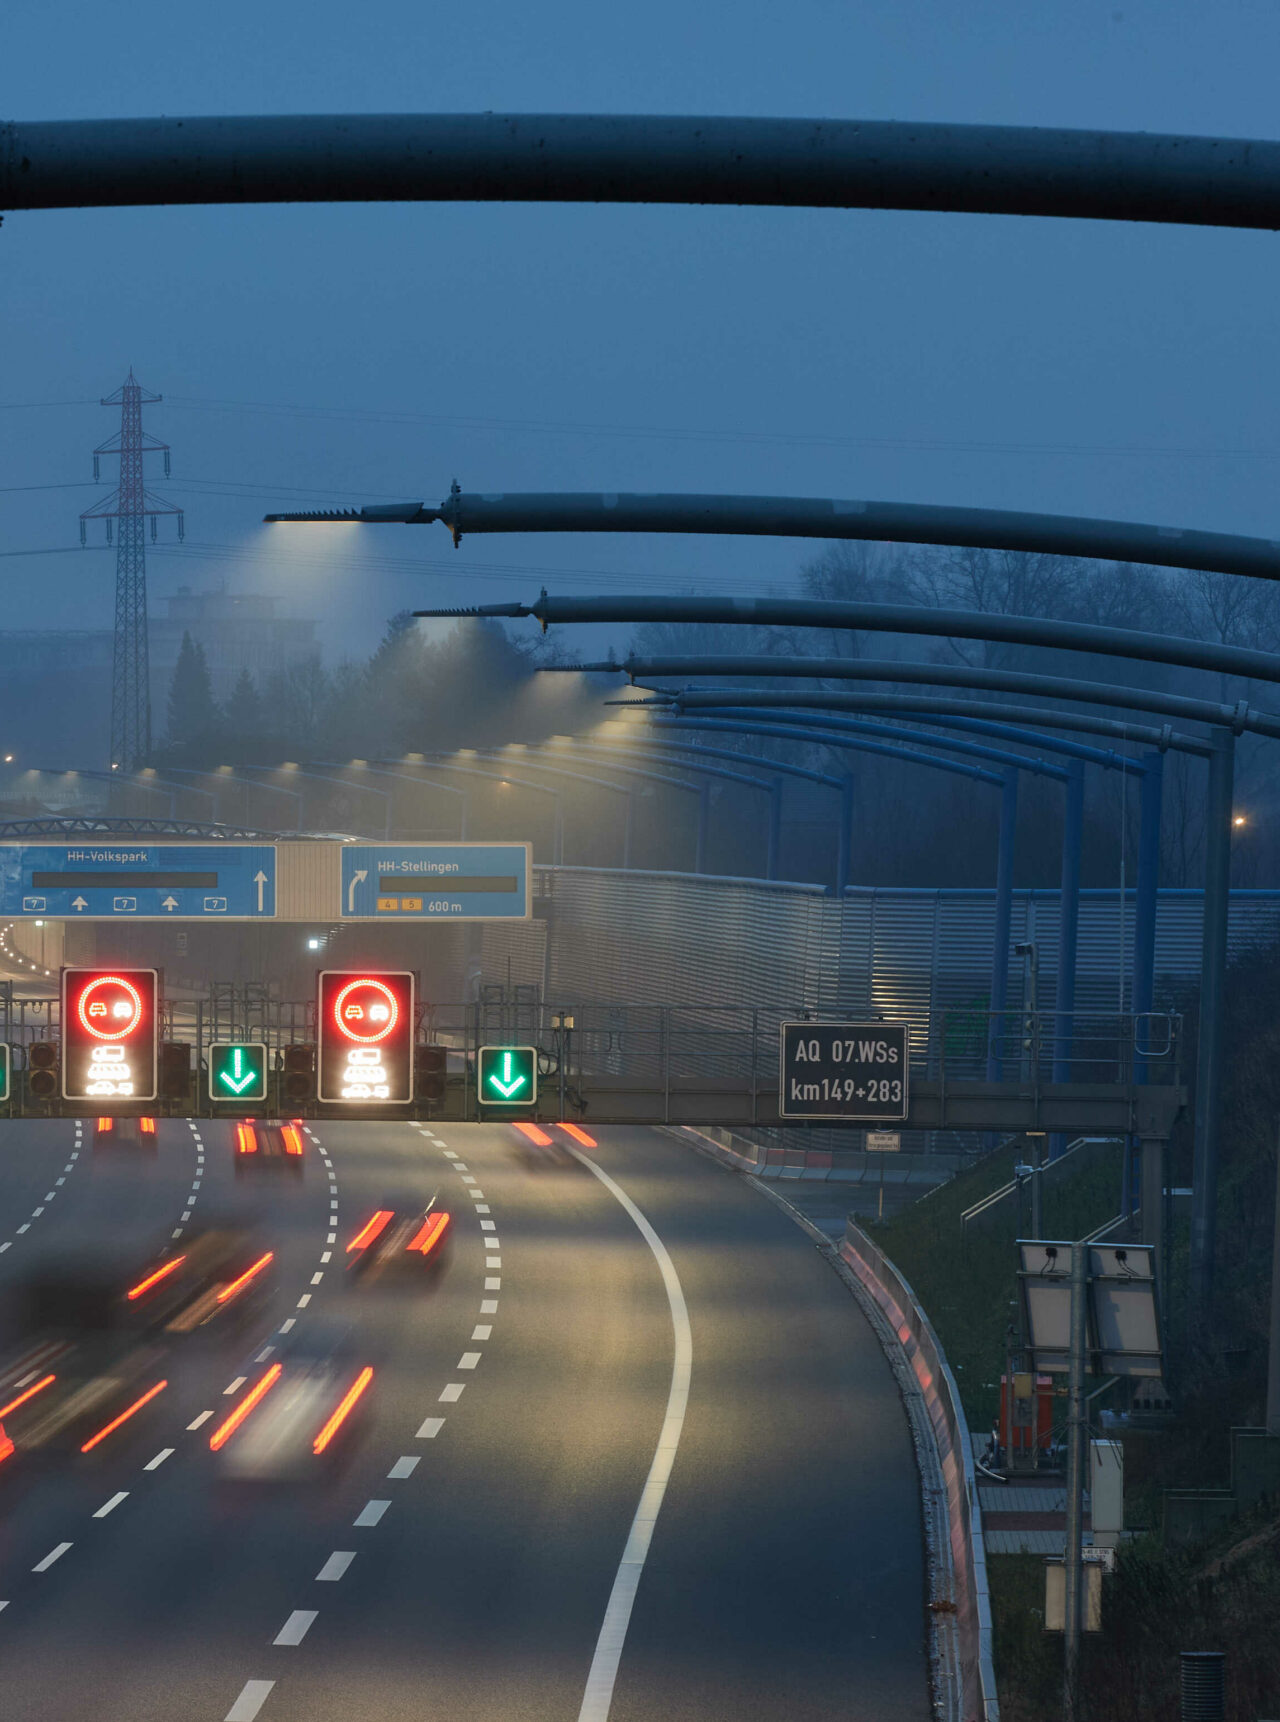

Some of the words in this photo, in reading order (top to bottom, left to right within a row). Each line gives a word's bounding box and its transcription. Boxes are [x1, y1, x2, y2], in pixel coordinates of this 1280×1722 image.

[67, 851, 148, 864] HH-Volkspark
[378, 861, 459, 874] HH-Stellingen
[428, 901, 449, 912] 600
[451, 903, 462, 912] m
[795, 1040, 821, 1062] AQ
[832, 1040, 899, 1063] 07.WSs
